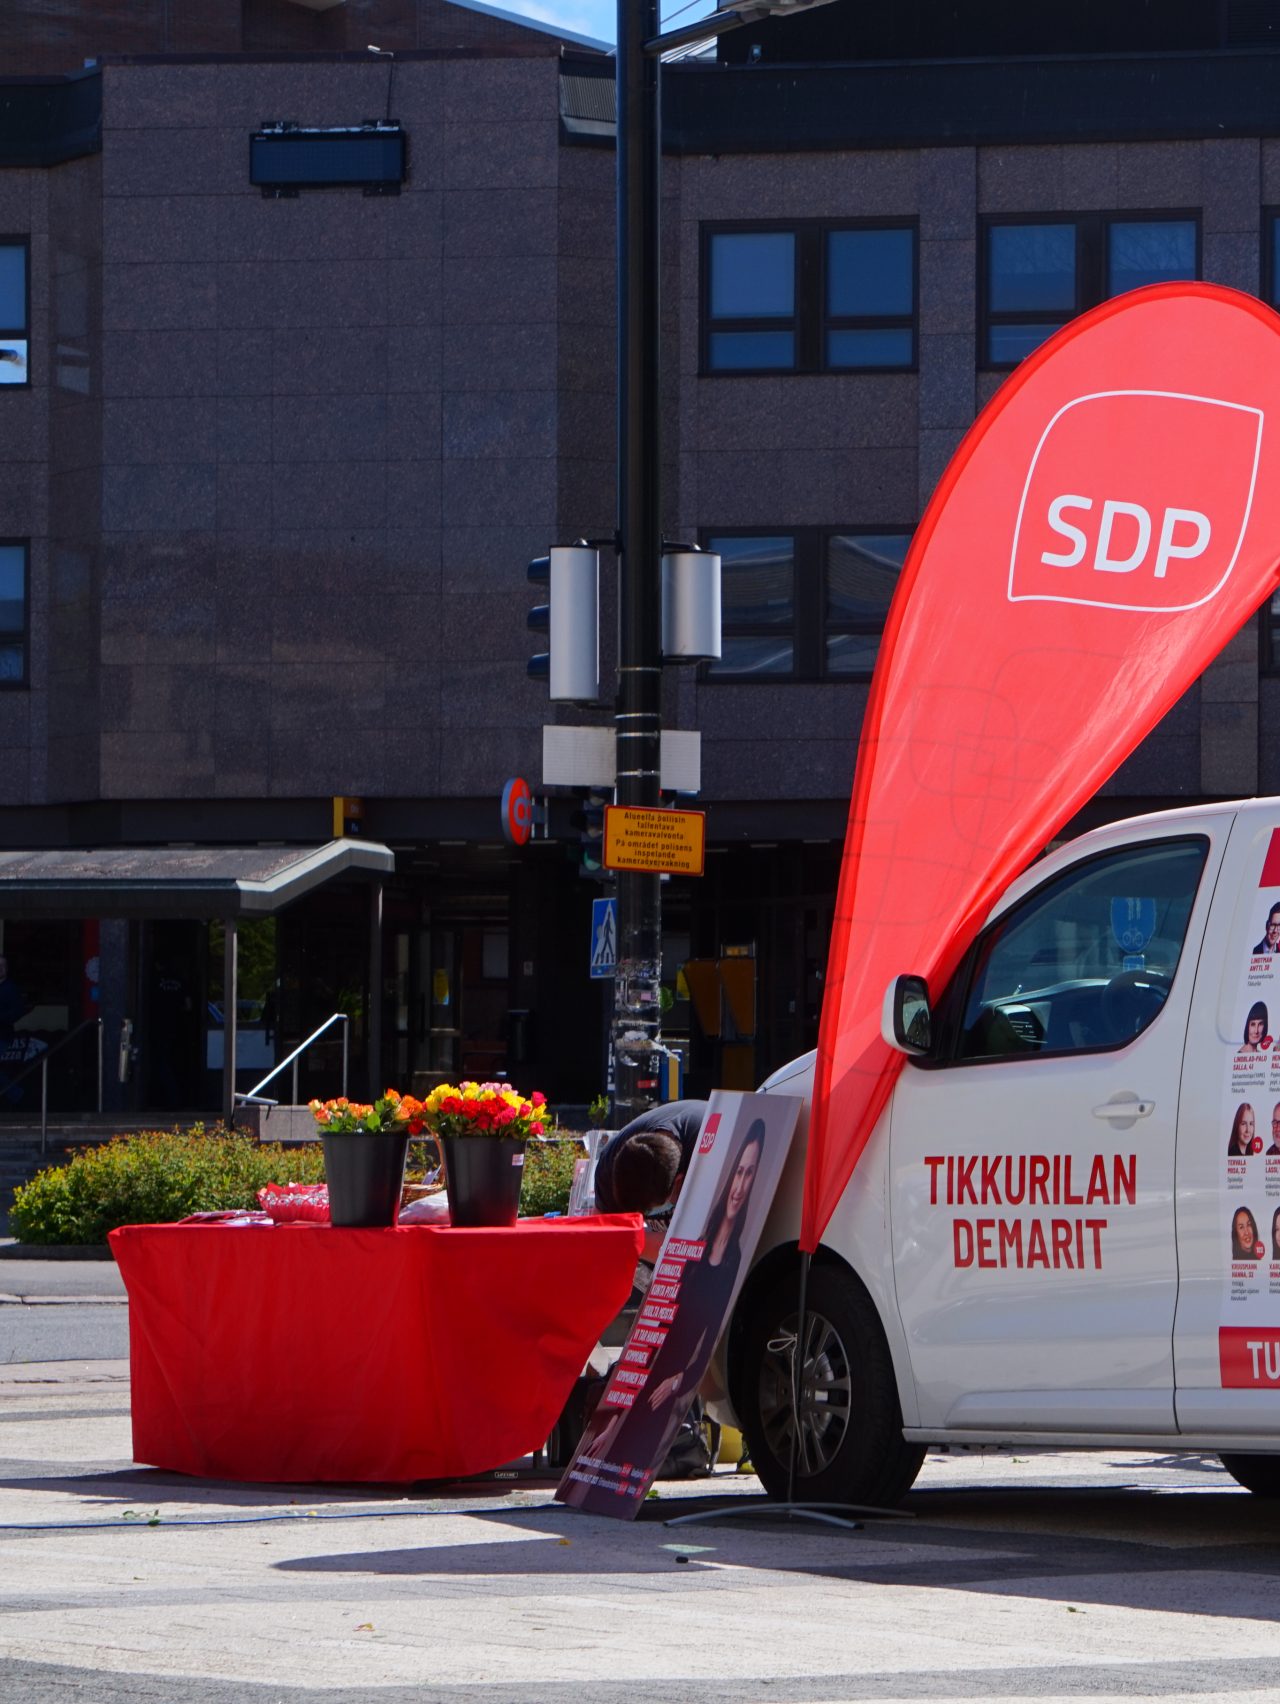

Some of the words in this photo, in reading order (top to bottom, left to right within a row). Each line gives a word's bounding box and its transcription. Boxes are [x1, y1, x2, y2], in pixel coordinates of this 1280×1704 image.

[1041, 495, 1211, 578] SDP
[624, 812, 655, 821] Alueella
[657, 815, 686, 824] poliisin
[637, 822, 675, 831] tallentava
[625, 829, 684, 840] kameravalvonta
[628, 840, 659, 849] området
[661, 843, 692, 853] polisens
[634, 849, 676, 859] inspelande
[617, 856, 690, 869] kameraövervakning
[701, 1133, 715, 1148] SDP
[924, 1154, 1137, 1206] TIKKURILAN
[953, 1219, 1108, 1270] DEMARIT
